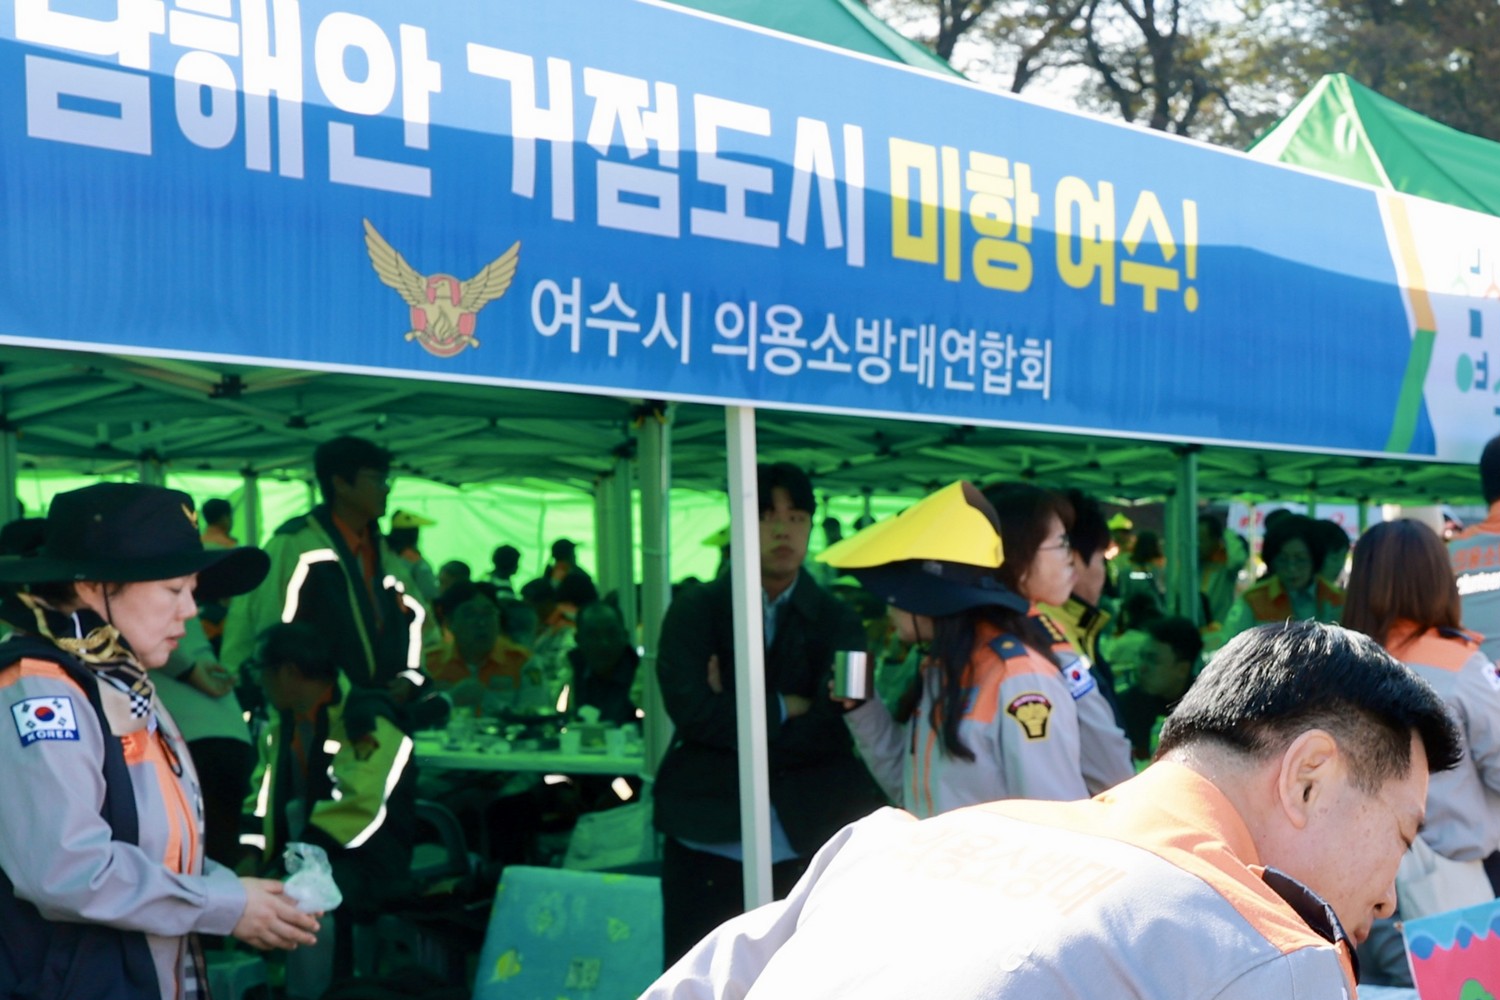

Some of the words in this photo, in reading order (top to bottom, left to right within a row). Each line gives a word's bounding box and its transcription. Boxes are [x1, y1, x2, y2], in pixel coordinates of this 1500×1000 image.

[14, 0, 442, 198] 남해안
[467, 42, 865, 268] 거점도시
[889, 136, 1039, 293] 미항
[1055, 174, 1199, 313] 여수!
[530, 277, 691, 364] 여수시
[712, 300, 1053, 399] 의용소방대연합회
[28, 730, 74, 741] KOREA
